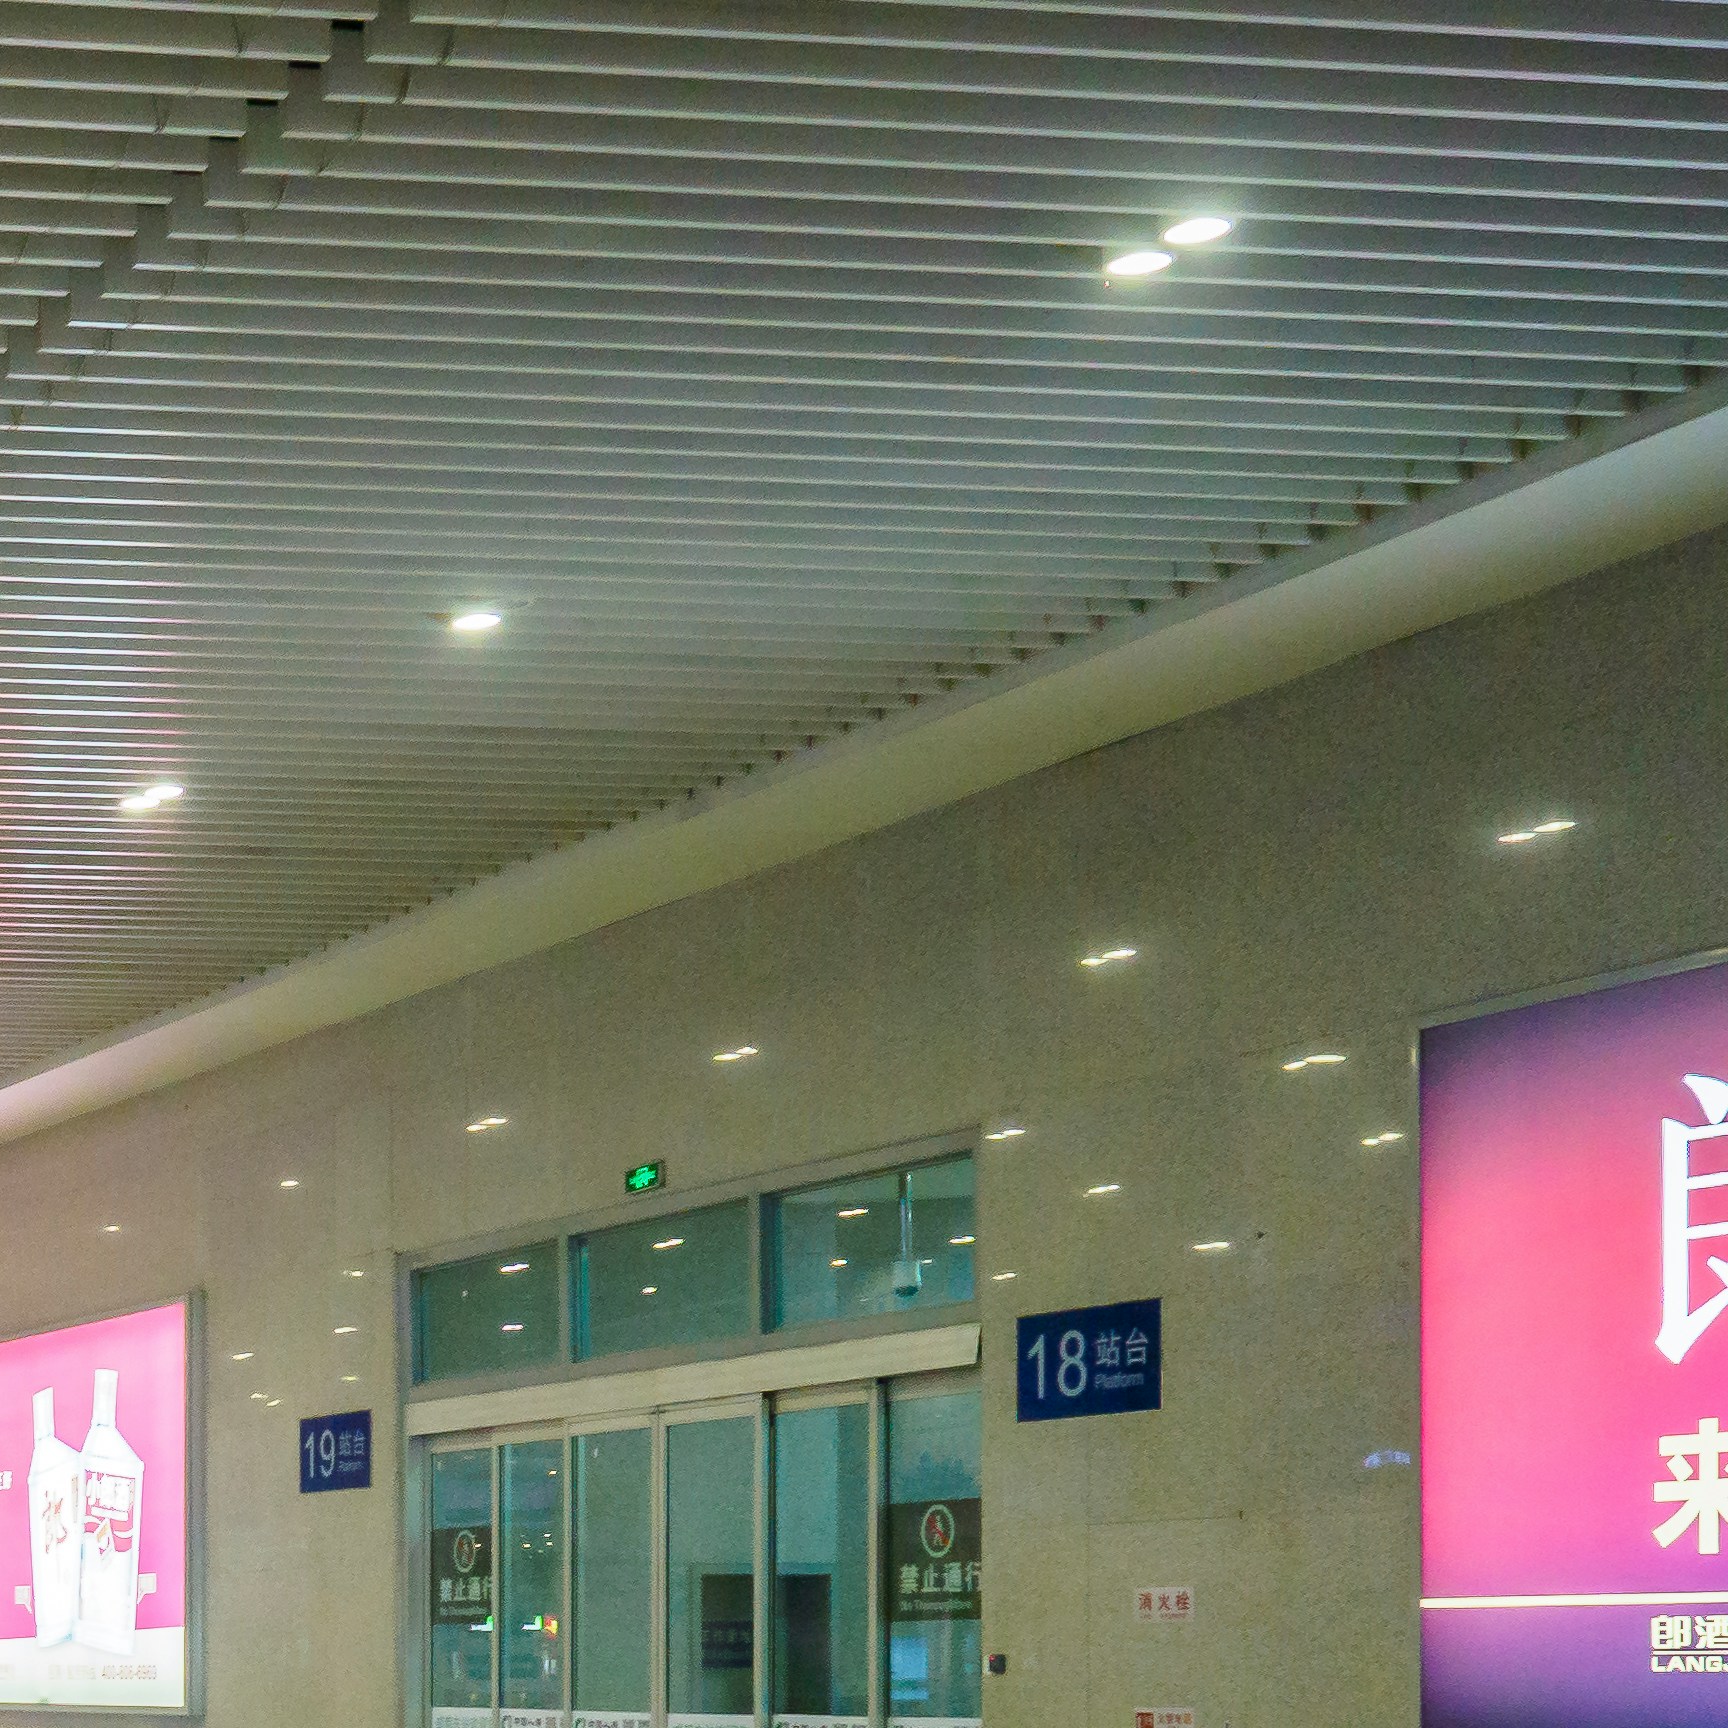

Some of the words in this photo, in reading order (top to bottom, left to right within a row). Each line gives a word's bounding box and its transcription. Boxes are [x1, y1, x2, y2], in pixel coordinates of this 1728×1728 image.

[1026, 1330, 1088, 1397] 18
[1096, 1327, 1148, 1366] 站台
[1095, 1371, 1144, 1389] Platform
[305, 1429, 336, 1478] 19
[339, 1428, 366, 1456] 站台
[1651, 1655, 1728, 1673] LANG
